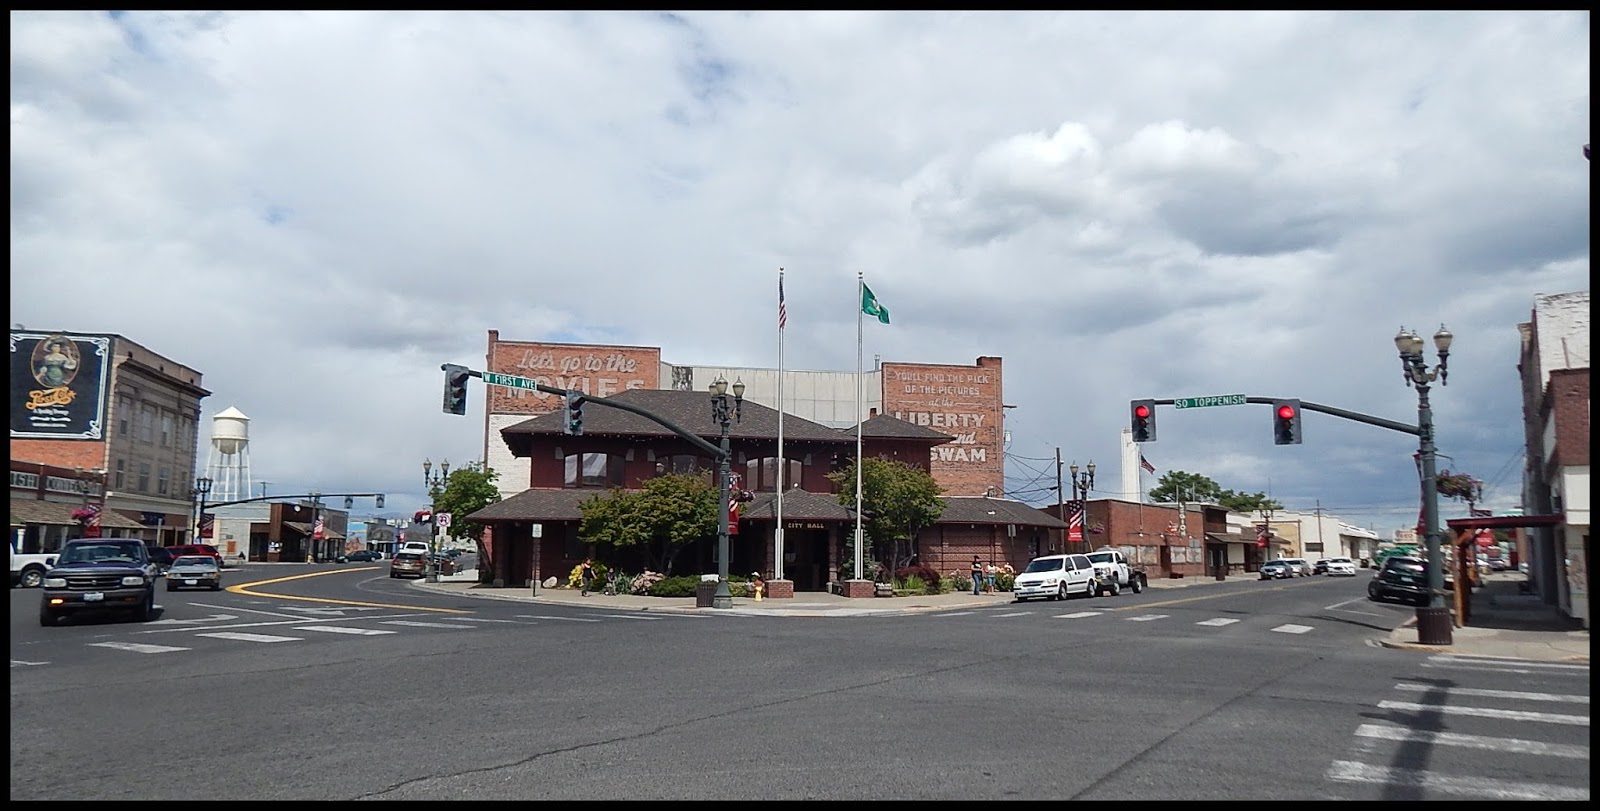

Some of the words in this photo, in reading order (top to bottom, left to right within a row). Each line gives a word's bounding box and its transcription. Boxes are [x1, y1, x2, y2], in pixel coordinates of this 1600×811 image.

[517, 349, 555, 369] Let's
[560, 355, 581, 375] go
[585, 353, 603, 371] to
[606, 353, 637, 373] the
[484, 373, 490, 382] W
[495, 375, 516, 387] FIRST
[521, 379, 535, 389] AVE
[924, 373, 944, 382] FIND
[947, 373, 964, 383] THE
[967, 374, 989, 384] PICK
[905, 384, 917, 394] OF
[920, 385, 936, 394] THE
[938, 385, 980, 396] PICTURES
[928, 398, 939, 406] at
[941, 397, 954, 407] the
[1176, 399, 1188, 408] SO
[1194, 395, 1245, 407] TOPPENISH
